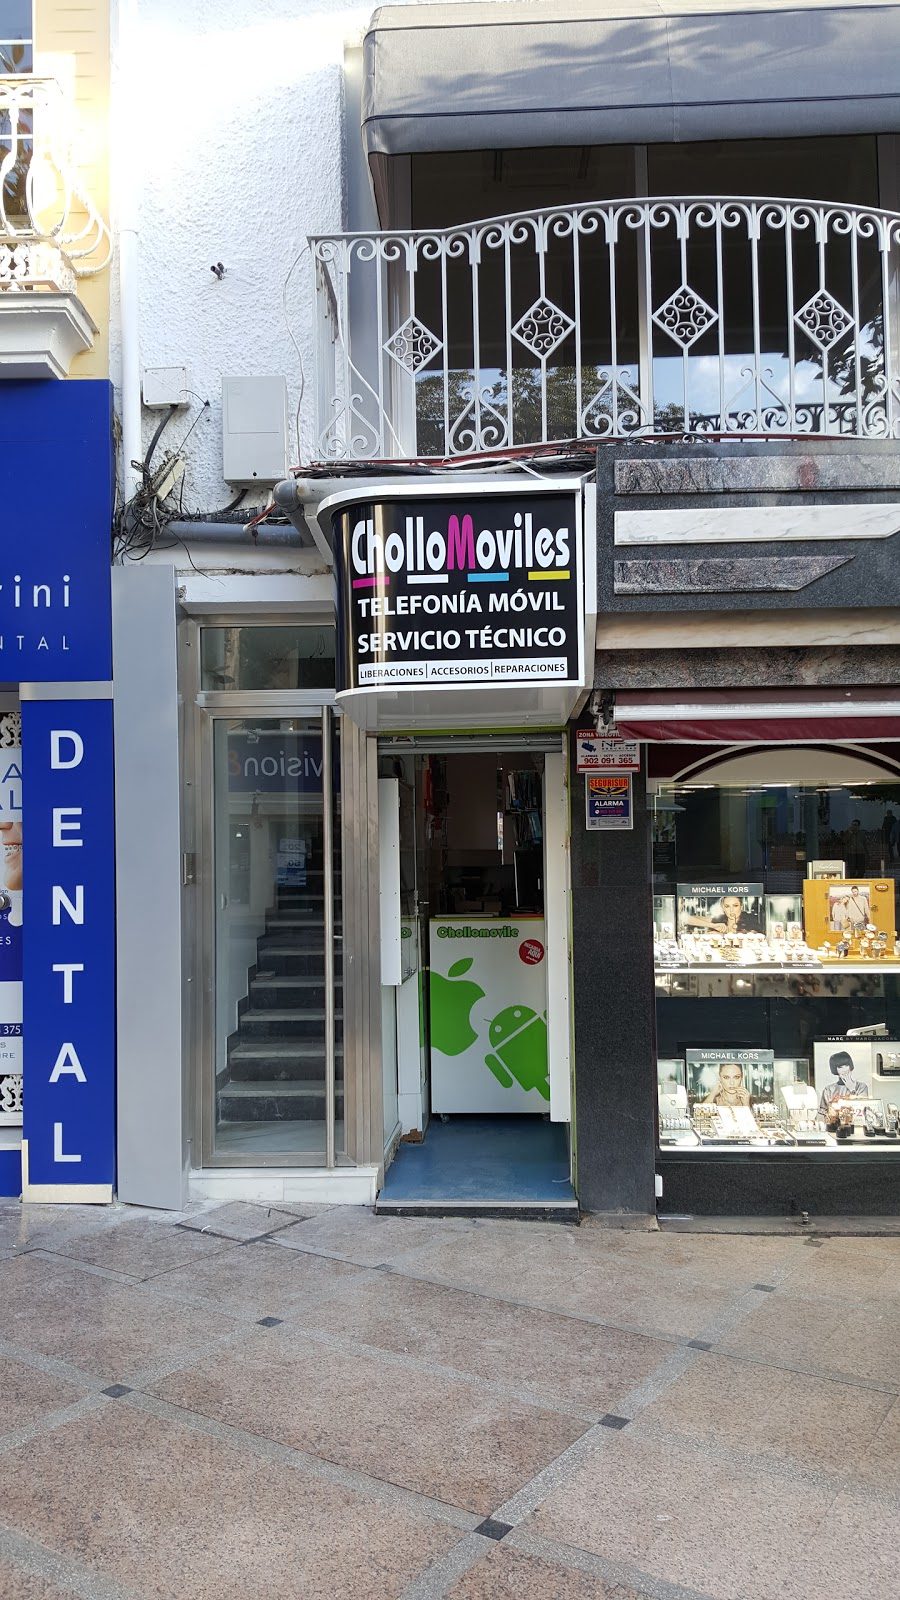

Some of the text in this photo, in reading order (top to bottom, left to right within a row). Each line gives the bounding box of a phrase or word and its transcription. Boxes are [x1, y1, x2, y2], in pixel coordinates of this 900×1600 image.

[351, 512, 571, 575] CholloMoviles
[0, 574, 71, 608] ini
[357, 588, 566, 618] TELEFONÍA MÓVIL
[357, 625, 567, 654] SERVICIO TÉCNICO
[360, 663, 566, 679] LIBERACIONES ACCESORIOS REPARACIONES
[590, 778, 628, 787] SEGURISUR
[436, 925, 520, 939] Chollomovile
[46, 729, 87, 1163] DENTAL
[3, 1025, 21, 1035] 375
[701, 1052, 759, 1060] MICHAEL KORS
